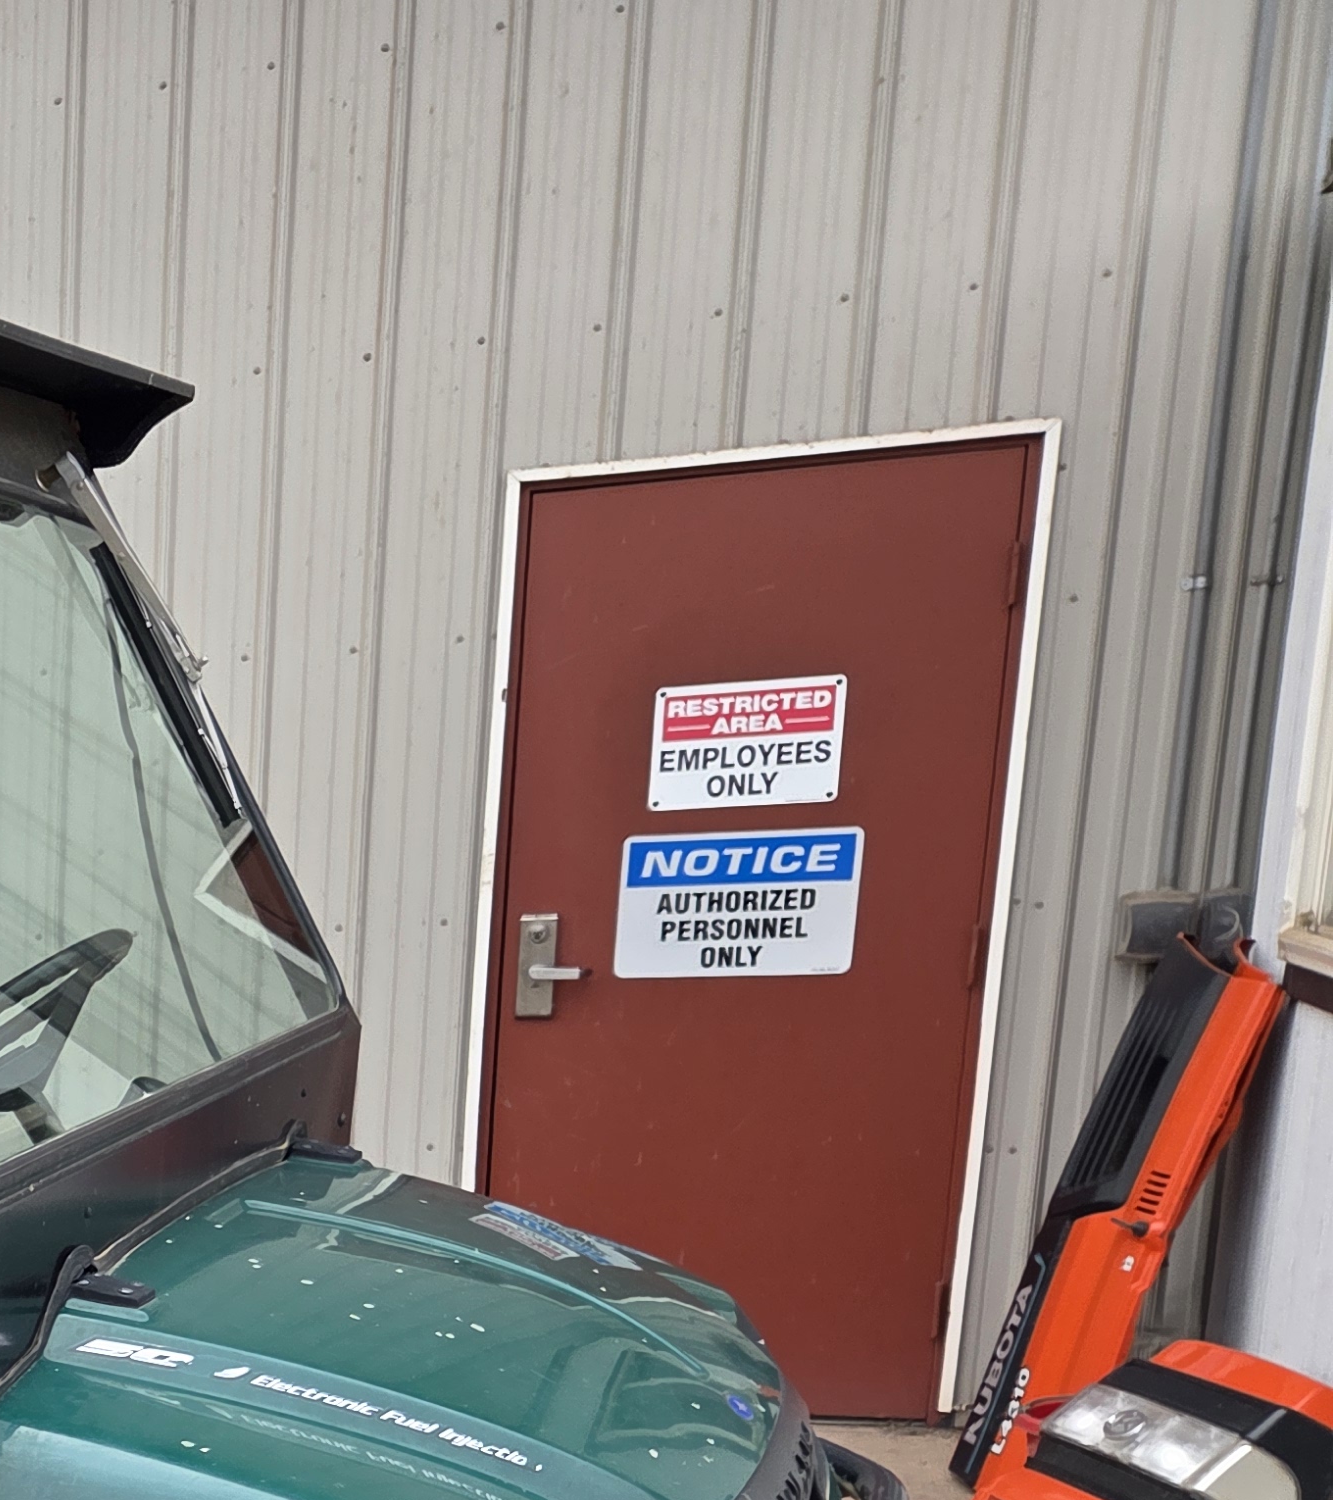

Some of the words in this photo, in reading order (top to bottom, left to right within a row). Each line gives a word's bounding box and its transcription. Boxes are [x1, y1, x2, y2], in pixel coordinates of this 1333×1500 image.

[667, 689, 832, 719] RESTRICTED
[711, 713, 783, 735] AREA
[659, 739, 832, 773] EMPLOYEES
[706, 771, 779, 798] ONLY
[640, 843, 842, 879] NOTICE
[656, 888, 817, 915] AUTHORIZED
[660, 917, 808, 942] PERSONNEL
[700, 945, 763, 968] ONLY
[963, 1284, 1033, 1445] KUBOTA
[249, 1374, 379, 1416] Electronic
[380, 1409, 440, 1434] Fuel
[438, 1427, 543, 1472] Injectio
